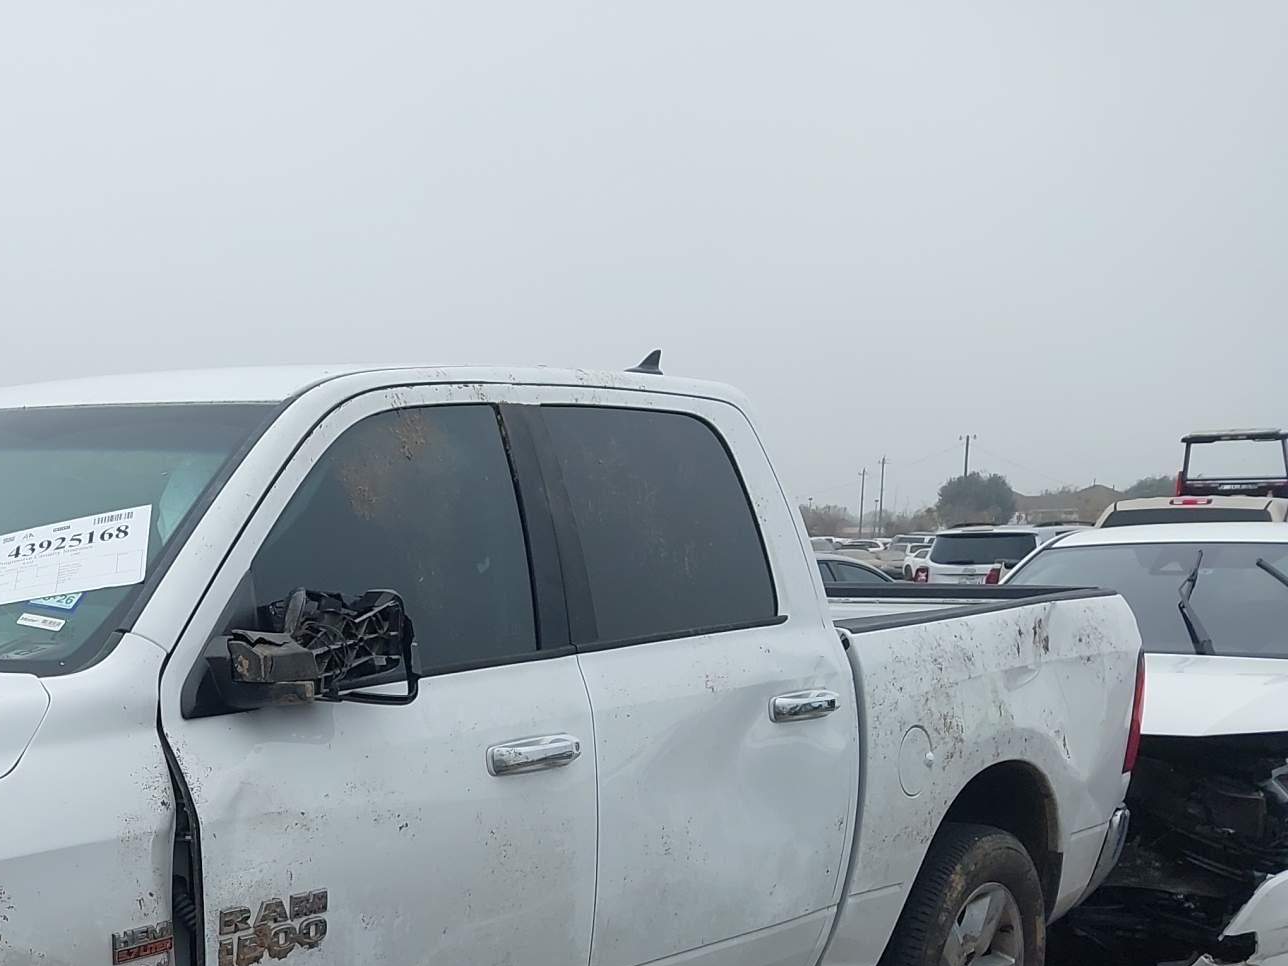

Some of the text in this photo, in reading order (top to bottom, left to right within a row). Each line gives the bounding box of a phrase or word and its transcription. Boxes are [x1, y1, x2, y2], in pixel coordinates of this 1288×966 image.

[8, 524, 130, 559] 43925168
[219, 888, 328, 936] RAM
[112, 920, 173, 951] HEMI
